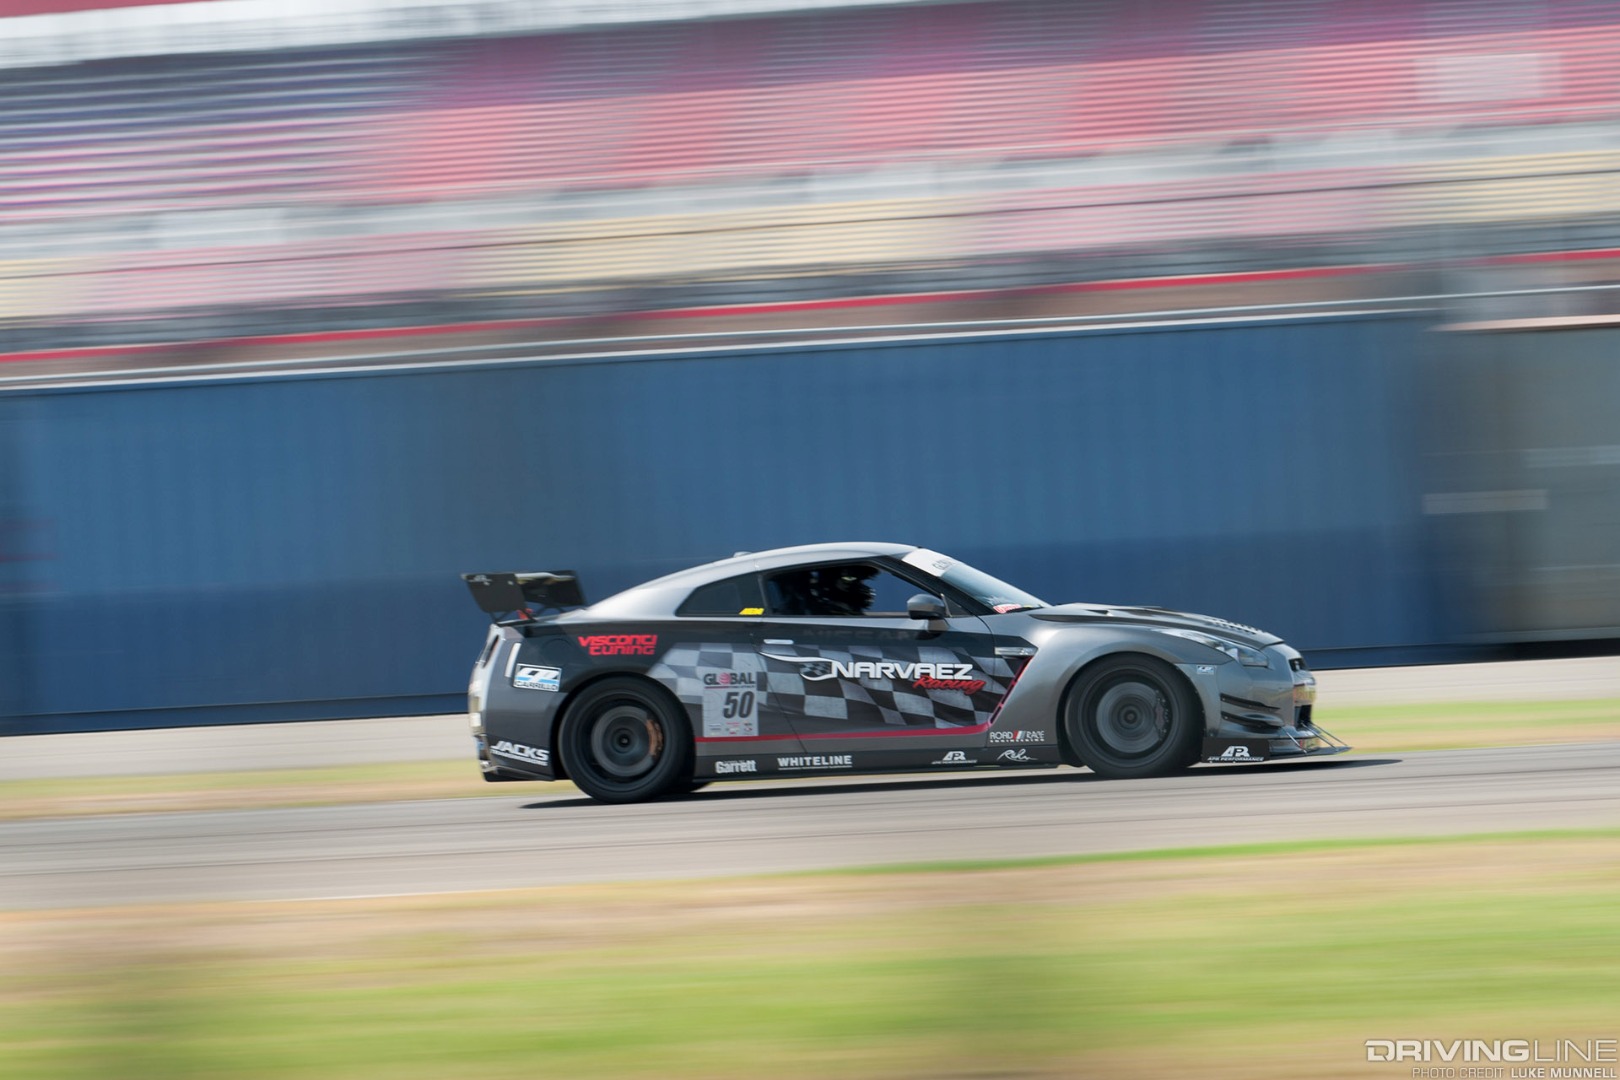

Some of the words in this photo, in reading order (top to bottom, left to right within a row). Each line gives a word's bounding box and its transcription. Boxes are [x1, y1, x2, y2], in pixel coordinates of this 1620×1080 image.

[831, 661, 974, 680] NARVAEZ
[703, 672, 755, 685] GLOBAL
[723, 690, 755, 719] 50
[989, 731, 1014, 740] ROAD
[490, 740, 549, 760] JACKS
[715, 759, 757, 774] Garrett
[777, 755, 852, 766] WHITELINE
